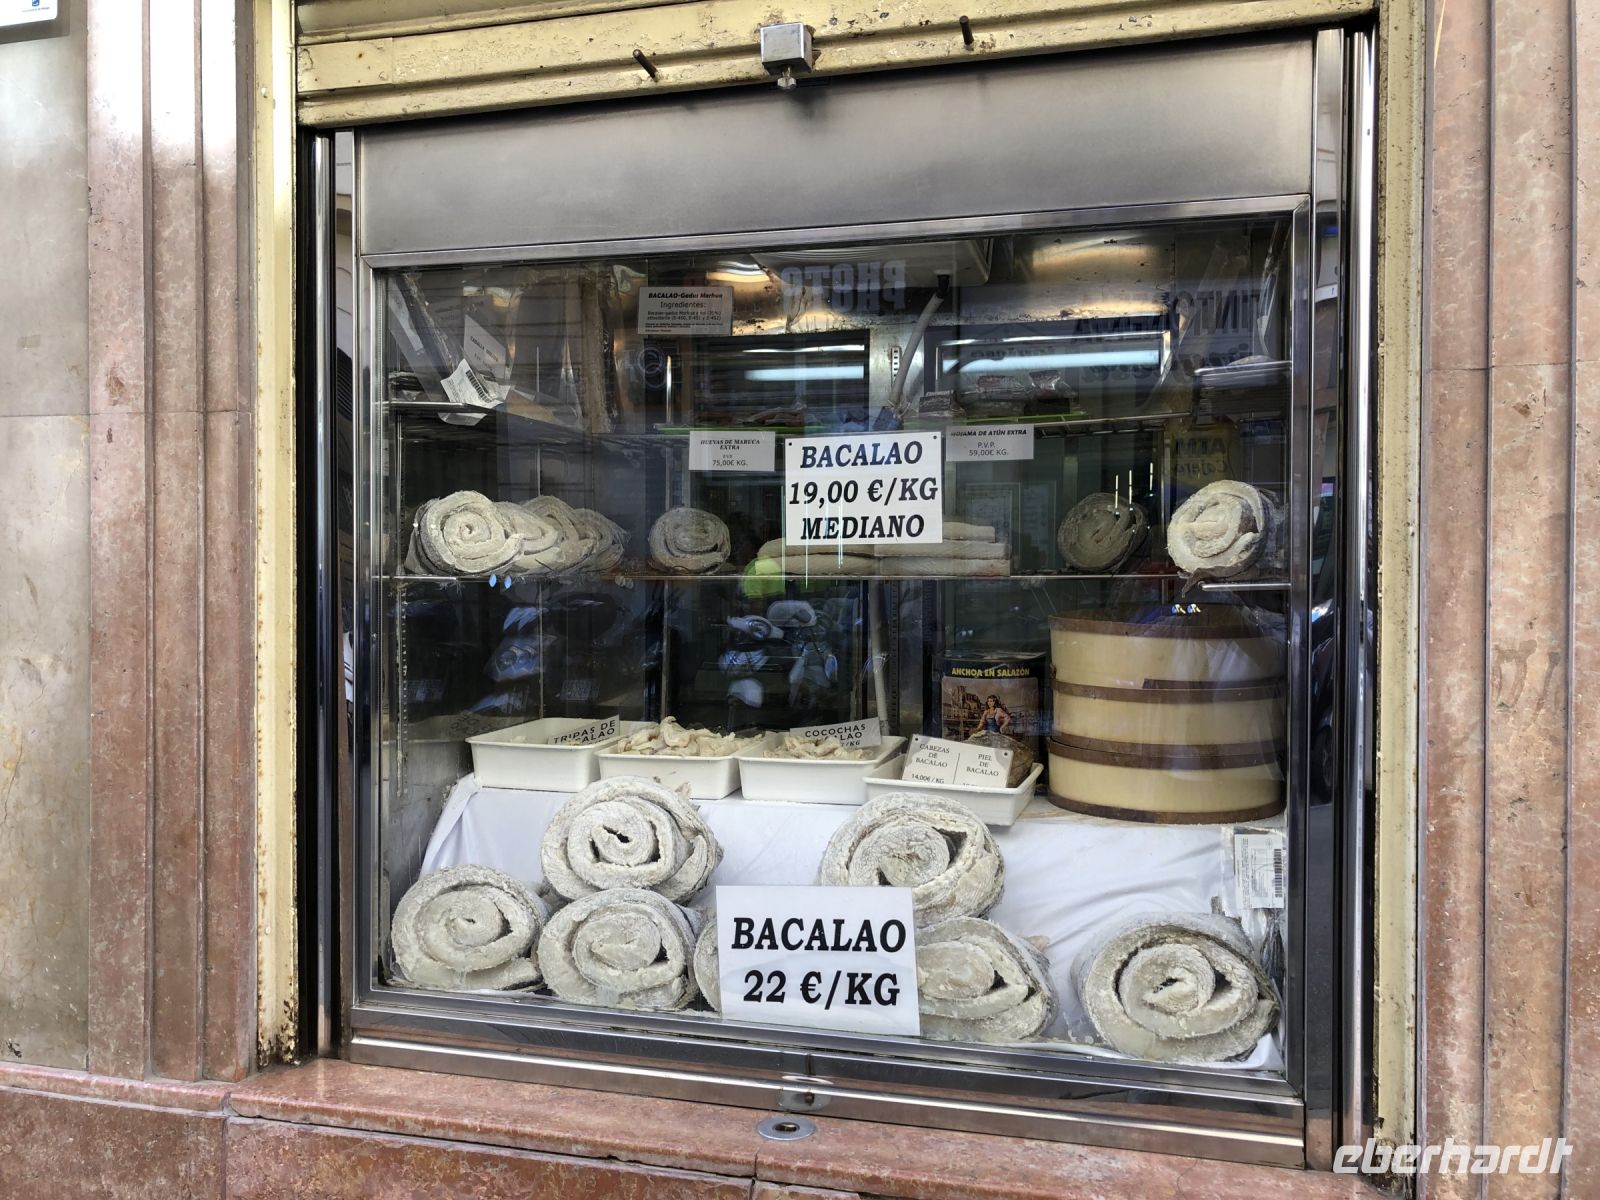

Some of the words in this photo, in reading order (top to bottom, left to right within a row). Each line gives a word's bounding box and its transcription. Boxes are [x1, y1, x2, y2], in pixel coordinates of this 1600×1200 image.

[800, 440, 923, 468] BACALAO
[789, 480, 859, 510] 19,00
[866, 477, 938, 506] €/KG
[800, 514, 925, 540] MEDIANO
[952, 668, 983, 677] ANCHOA
[984, 668, 996, 677] EN
[997, 668, 1030, 677] SALAZÓN
[554, 726, 596, 744] TRIPAS
[600, 720, 616, 730] DE
[805, 724, 866, 738] COCOCHAS
[920, 744, 950, 754] CABEZAS
[916, 758, 948, 768] BACALAO
[966, 766, 1000, 777] BACALAO
[731, 917, 906, 953] BACALAO
[743, 970, 786, 1004] 22
[800, 970, 900, 1010] €/KG
